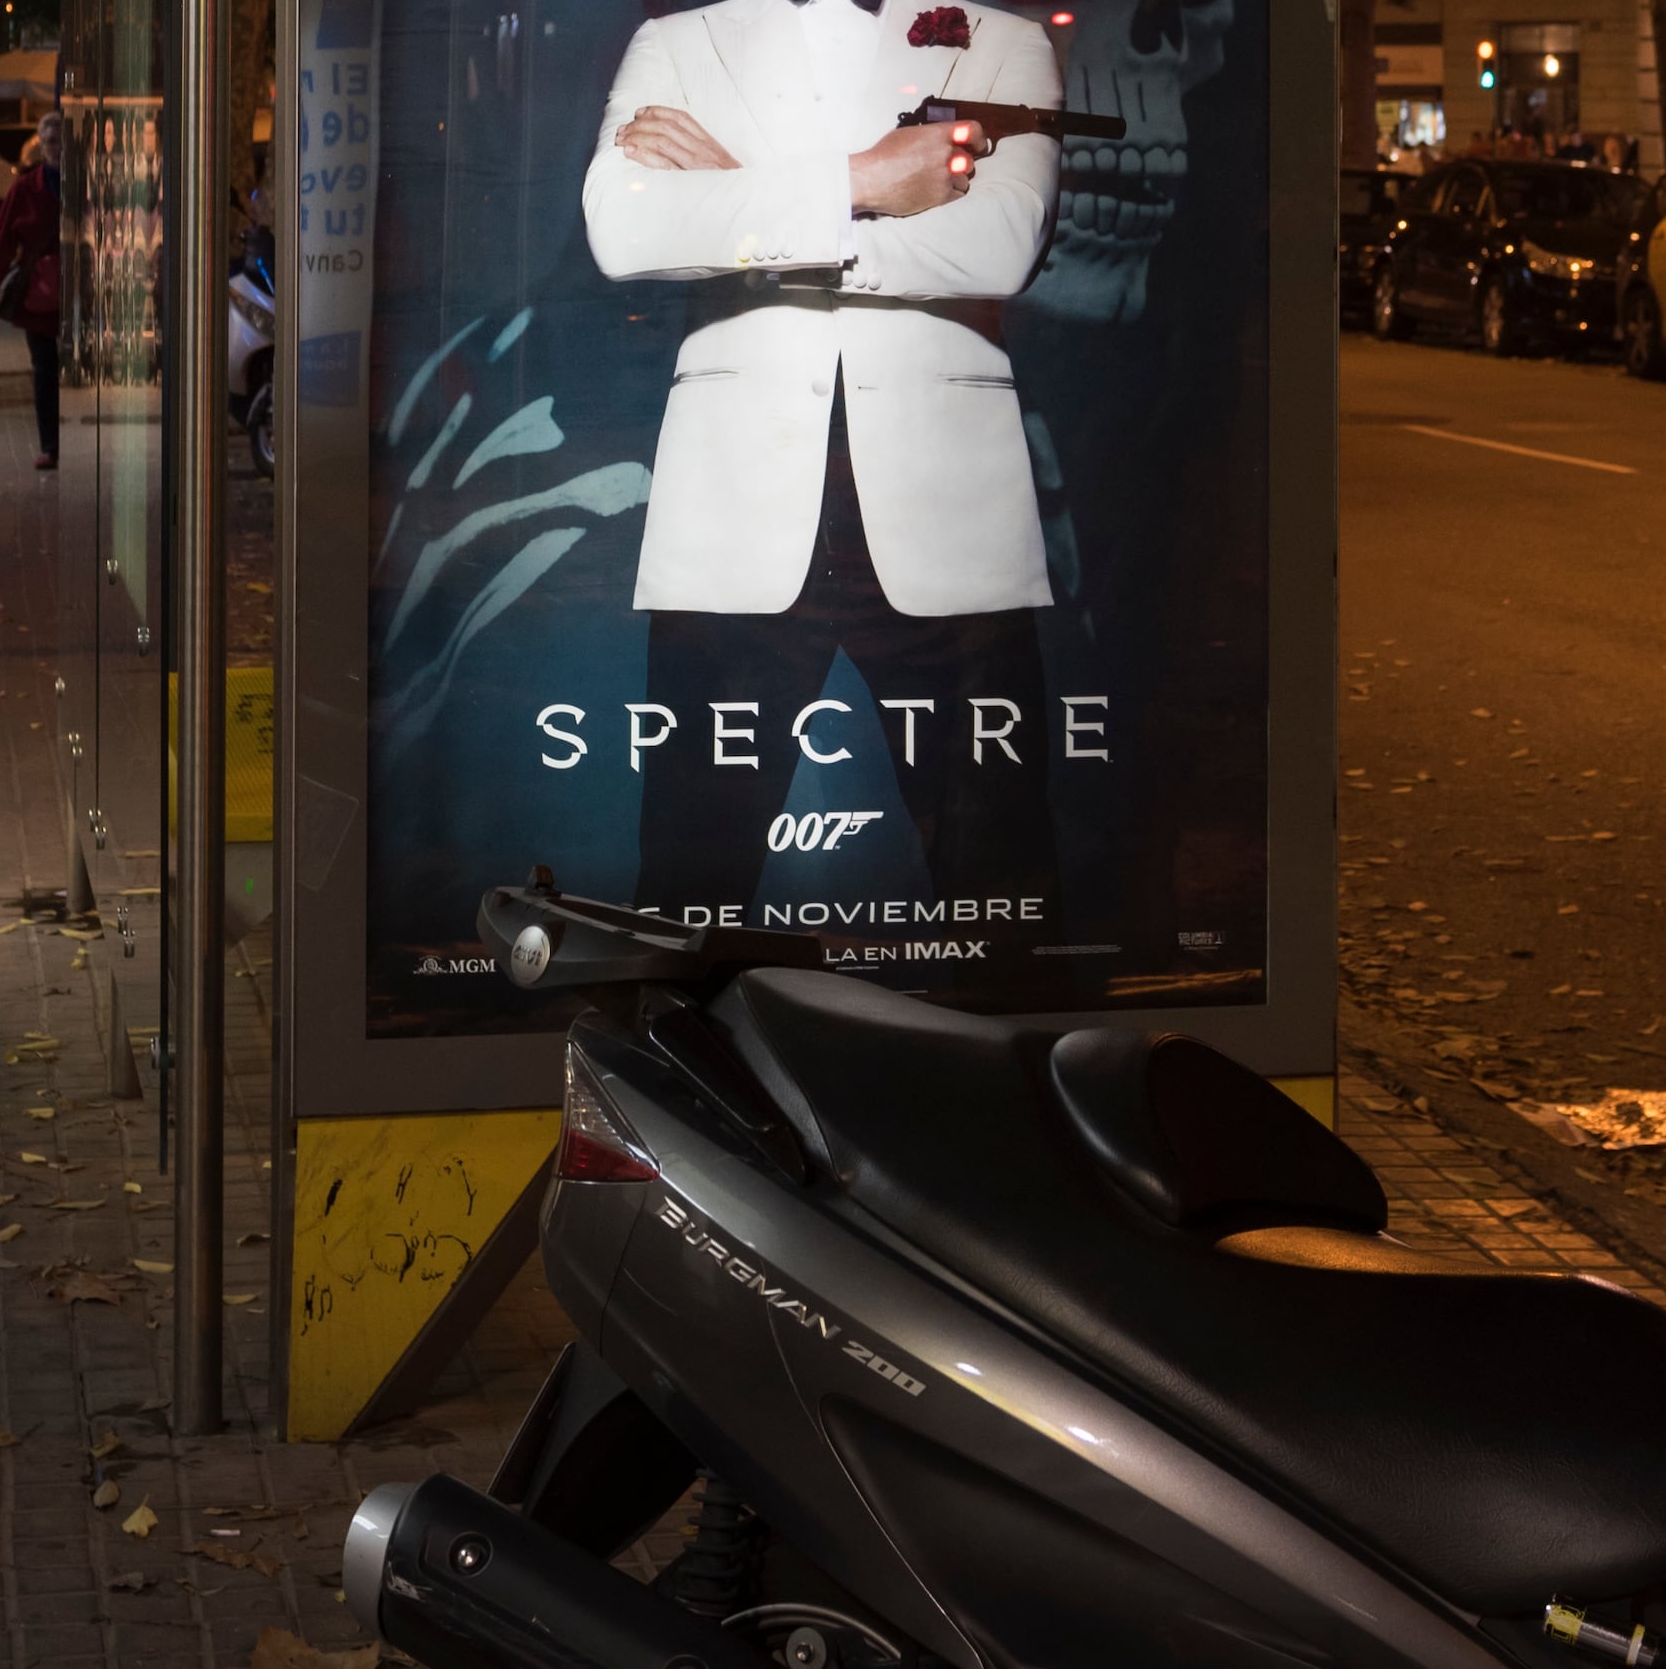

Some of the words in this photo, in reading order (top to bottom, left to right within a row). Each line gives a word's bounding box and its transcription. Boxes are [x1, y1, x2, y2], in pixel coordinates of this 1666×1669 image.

[534, 694, 1110, 773] SPECTRE
[766, 810, 883, 852] 007
[684, 905, 743, 928] DE
[764, 897, 1044, 926] NOVIEMBRE
[448, 958, 496, 974] MGM
[864, 946, 897, 961] EN
[905, 940, 986, 960] IMAX
[654, 1195, 840, 1341] BURGMAN
[840, 1339, 927, 1398] 200
